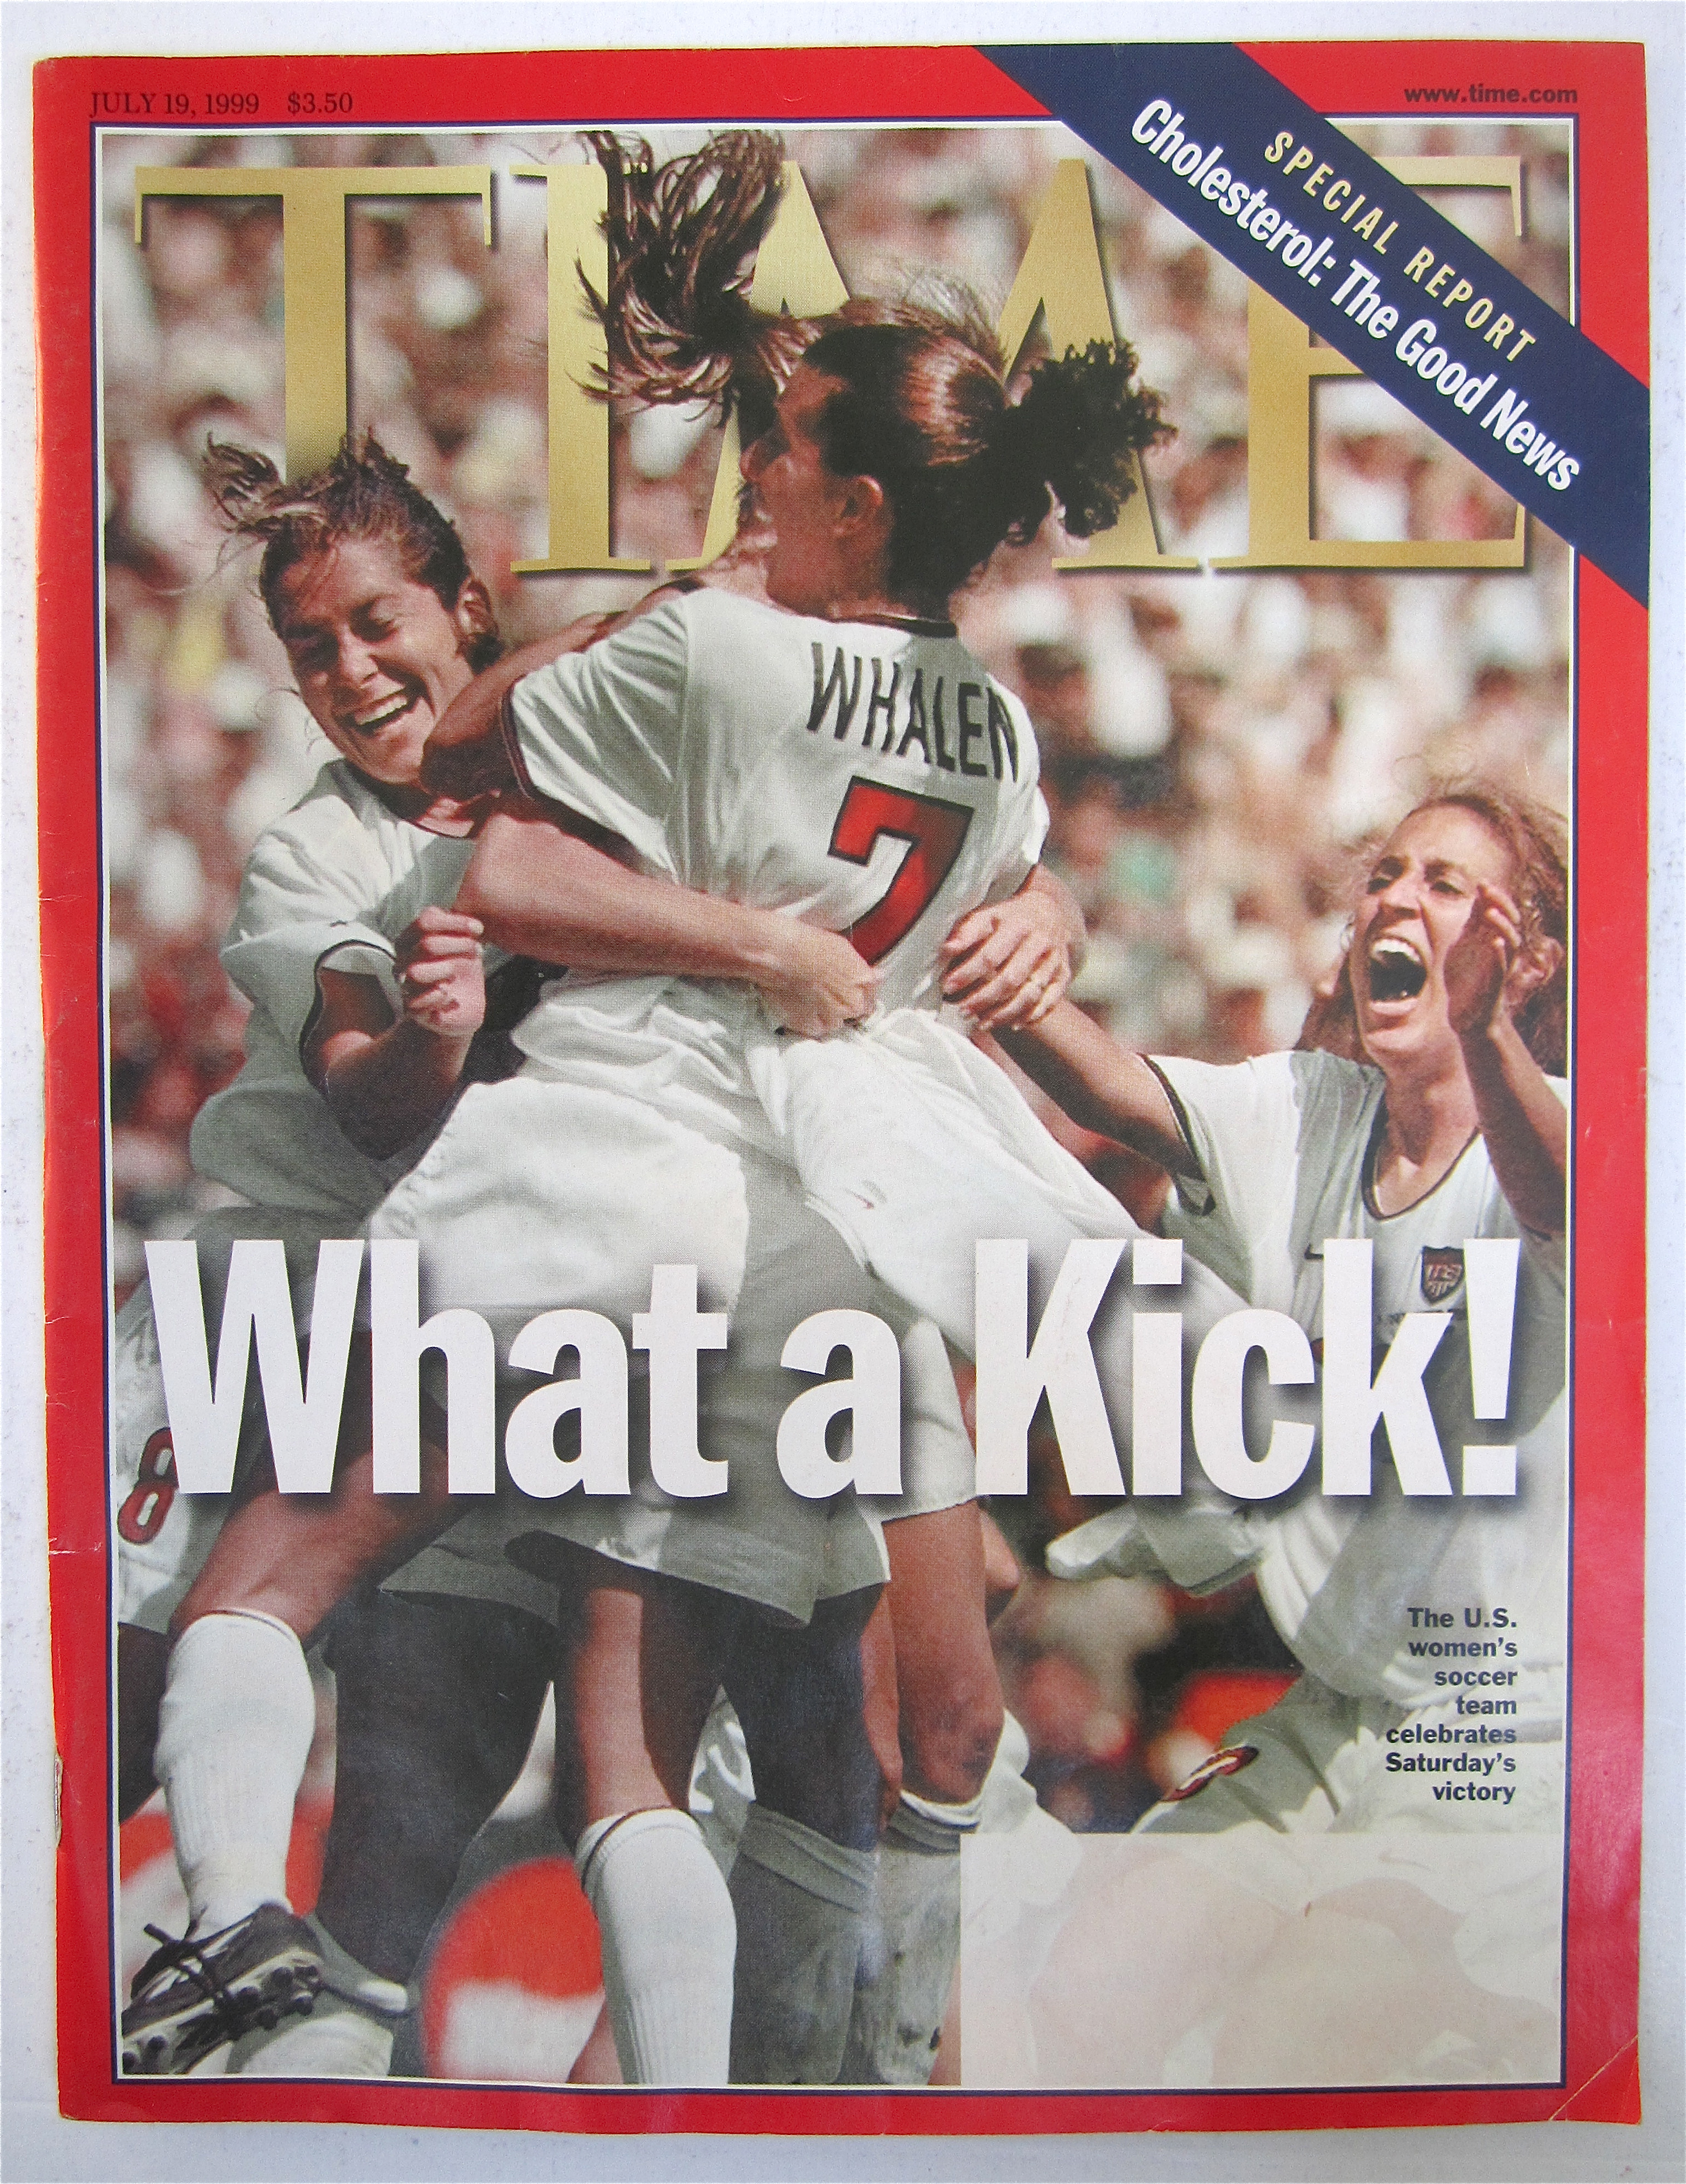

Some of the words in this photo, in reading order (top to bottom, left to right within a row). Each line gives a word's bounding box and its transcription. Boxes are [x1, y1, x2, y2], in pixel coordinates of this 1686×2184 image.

[89, 92, 156, 119] JULY
[165, 93, 197, 117] 19,
[205, 93, 260, 114] 1999
[287, 91, 353, 114] $3.50
[1404, 84, 1578, 104] www.time.com
[1264, 131, 1400, 255] SPECIAL
[1404, 247, 1535, 362] REPORT
[1131, 99, 1336, 288] Cholesterol:
[1330, 259, 1399, 340] The
[1395, 319, 1497, 416] Good
[1480, 388, 1581, 491] News
[806, 641, 1019, 782] WHALEN
[827, 775, 975, 967] 7
[144, 1239, 729, 1499] What
[775, 1309, 903, 1498] a
[975, 1239, 1521, 1500] Kick!
[117, 1427, 179, 1544] 8
[1407, 1608, 1454, 1628] The
[1464, 1608, 1518, 1628] U.S.
[1409, 1637, 1518, 1657] women's
[1435, 1671, 1518, 1686] soccer
[1456, 1695, 1517, 1715] team
[1385, 1724, 1517, 1743] celebrates
[1385, 1752, 1516, 1776] Saturday's
[1432, 1781, 1516, 1805] victory
